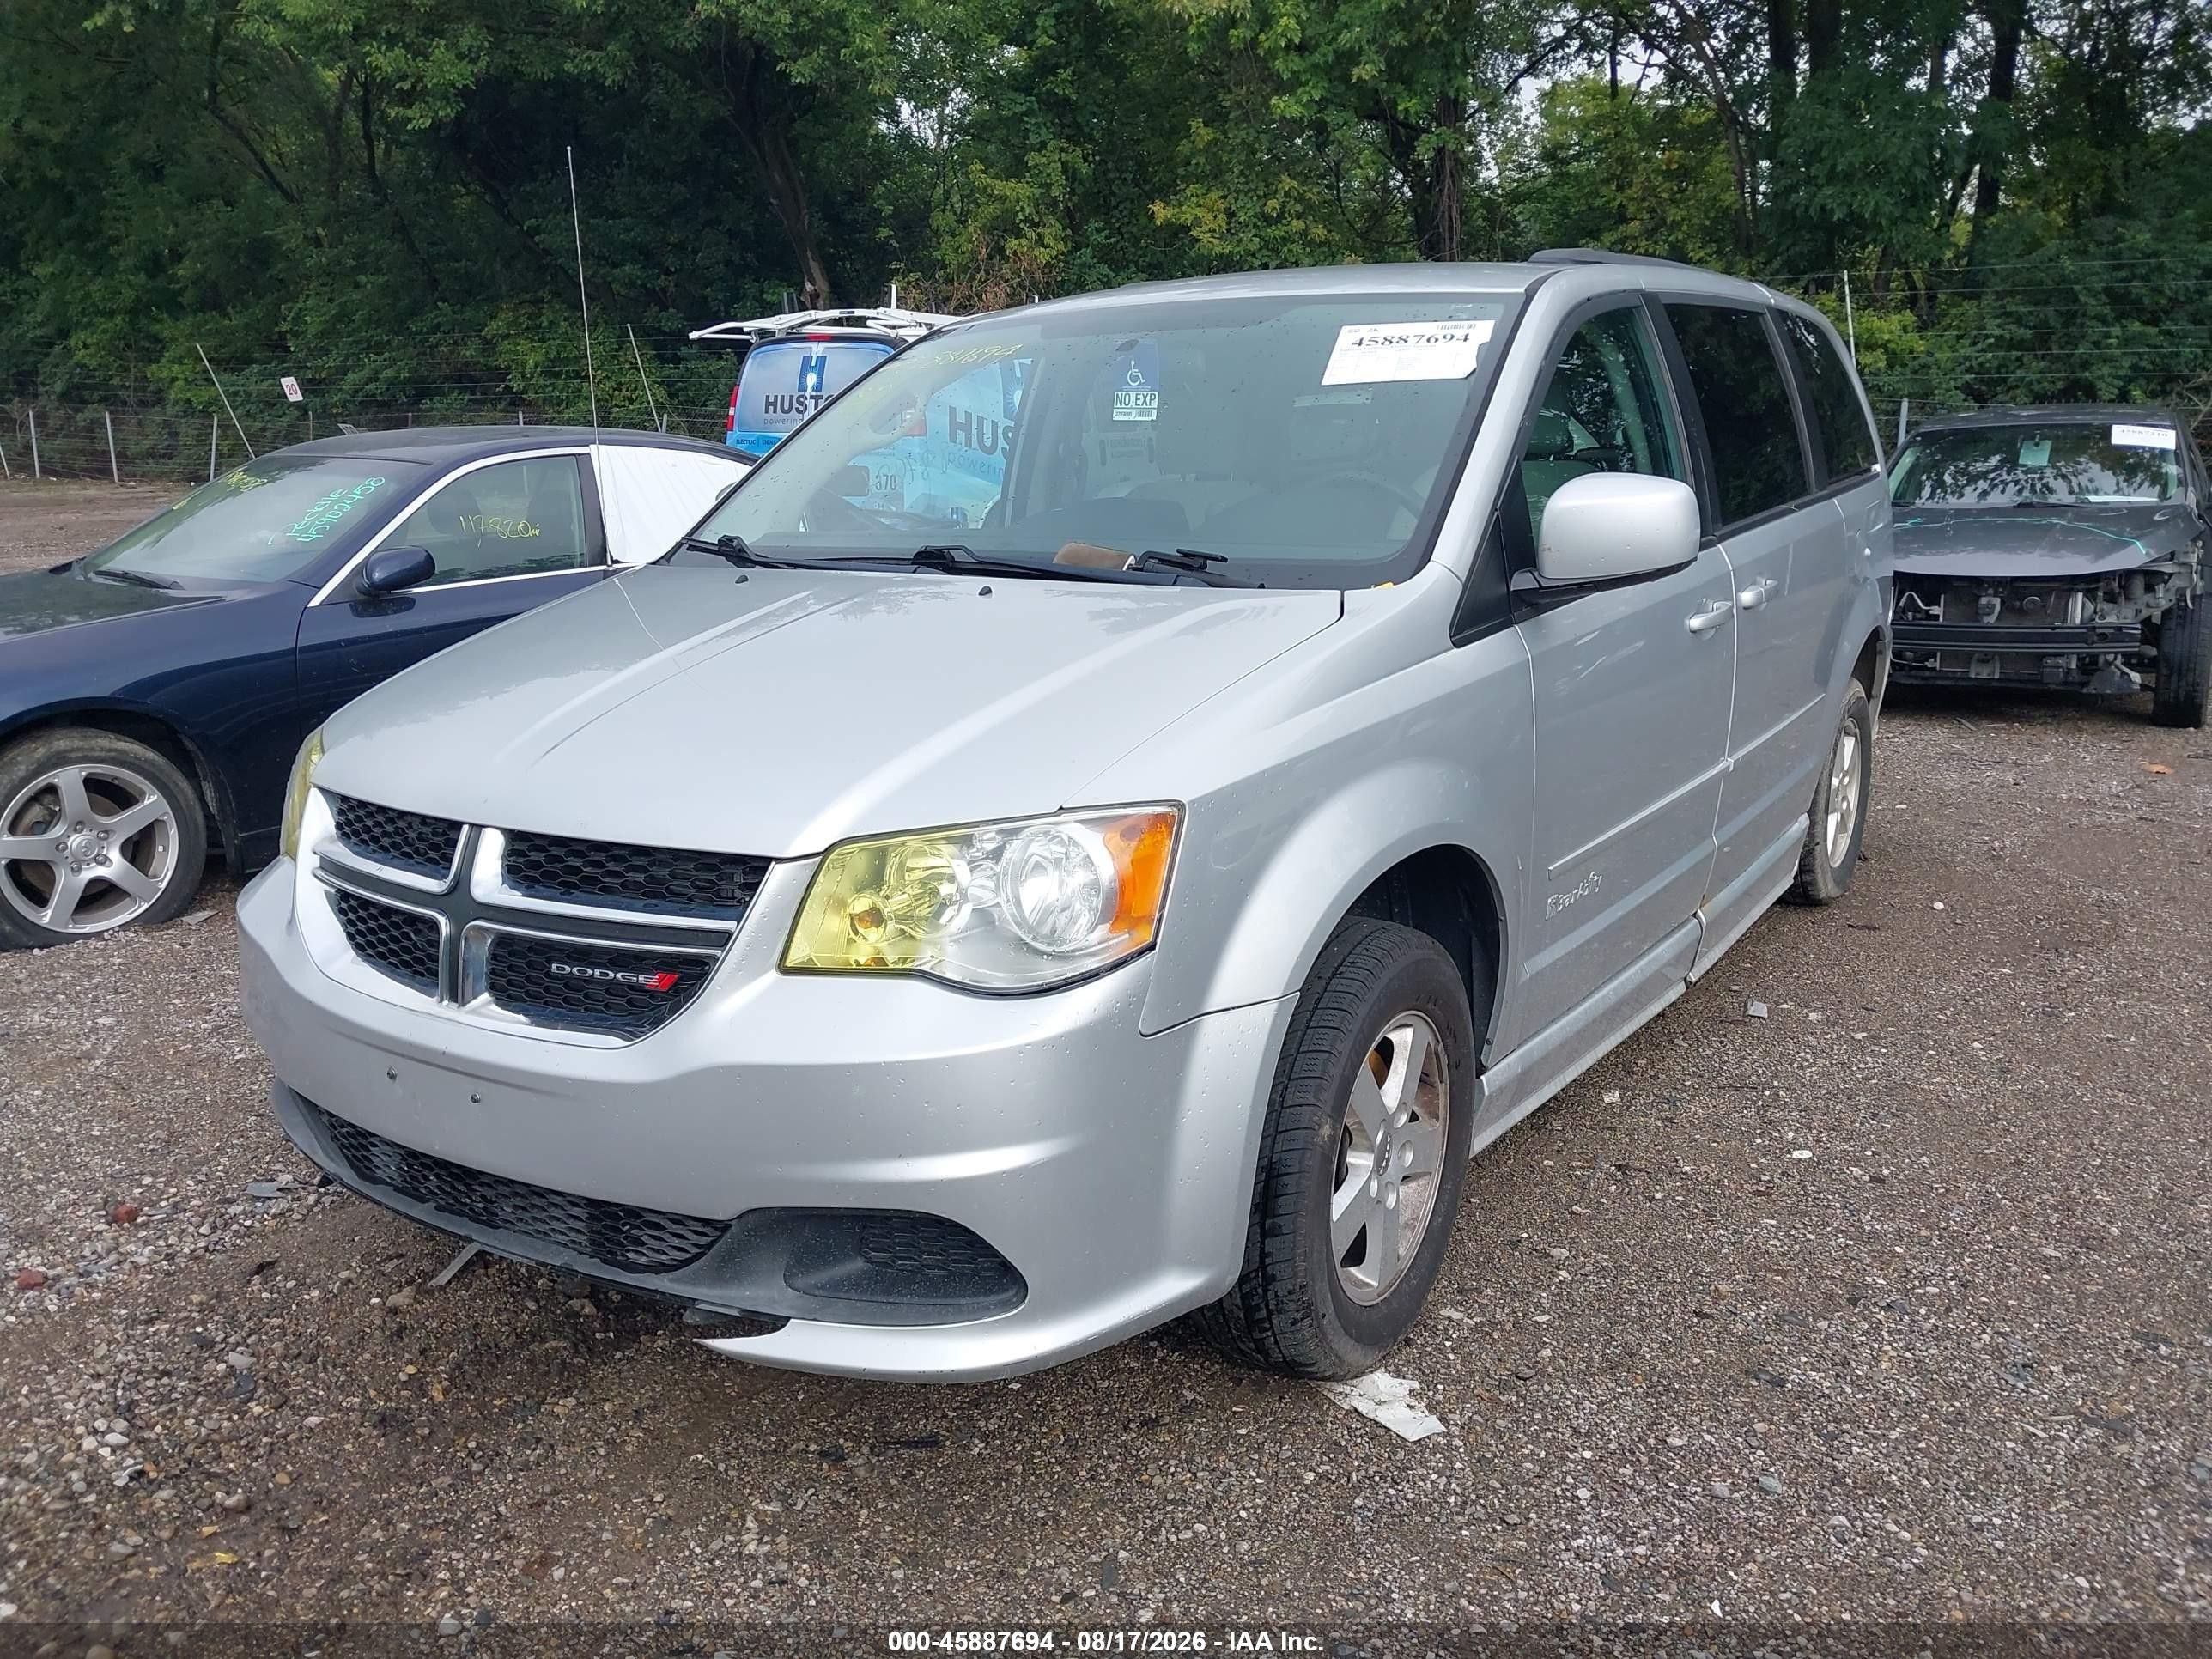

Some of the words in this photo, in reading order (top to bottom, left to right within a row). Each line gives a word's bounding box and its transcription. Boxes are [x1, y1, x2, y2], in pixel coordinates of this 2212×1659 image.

[1352, 332, 1471, 347] 45887694
[286, 383, 298, 396] 20
[1115, 392, 1131, 406] NO
[1134, 392, 1157, 406] EXP
[296, 477, 386, 542] 45902458
[550, 963, 659, 985] DODGE
